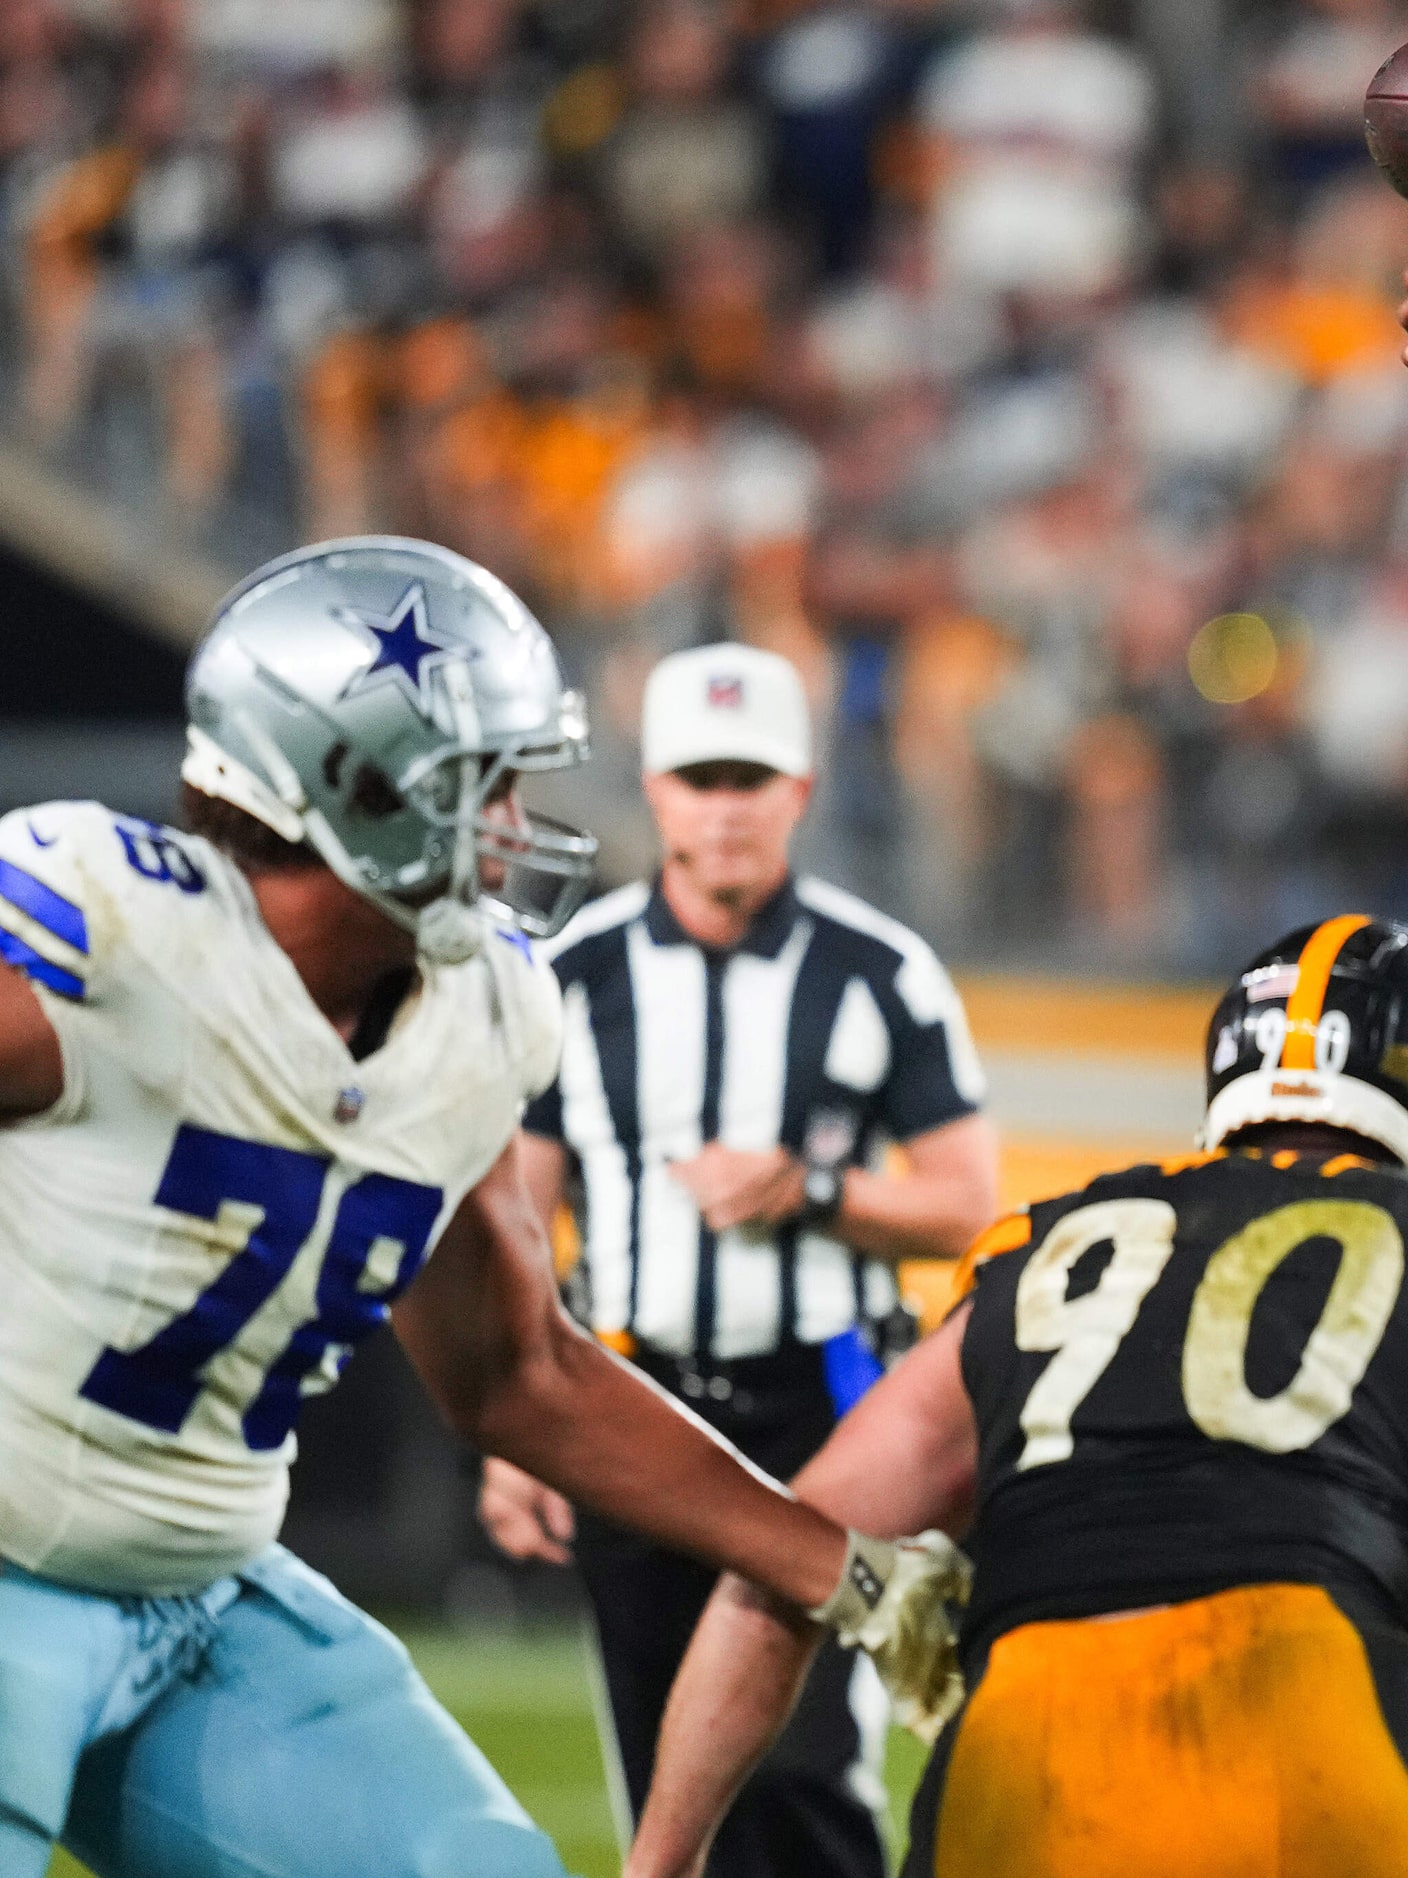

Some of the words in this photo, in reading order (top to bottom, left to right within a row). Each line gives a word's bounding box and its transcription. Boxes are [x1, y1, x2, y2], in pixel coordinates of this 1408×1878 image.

[1254, 1007, 1351, 1073] 90
[78, 1121, 446, 1451] 78
[1015, 1196, 1405, 1472] 90
